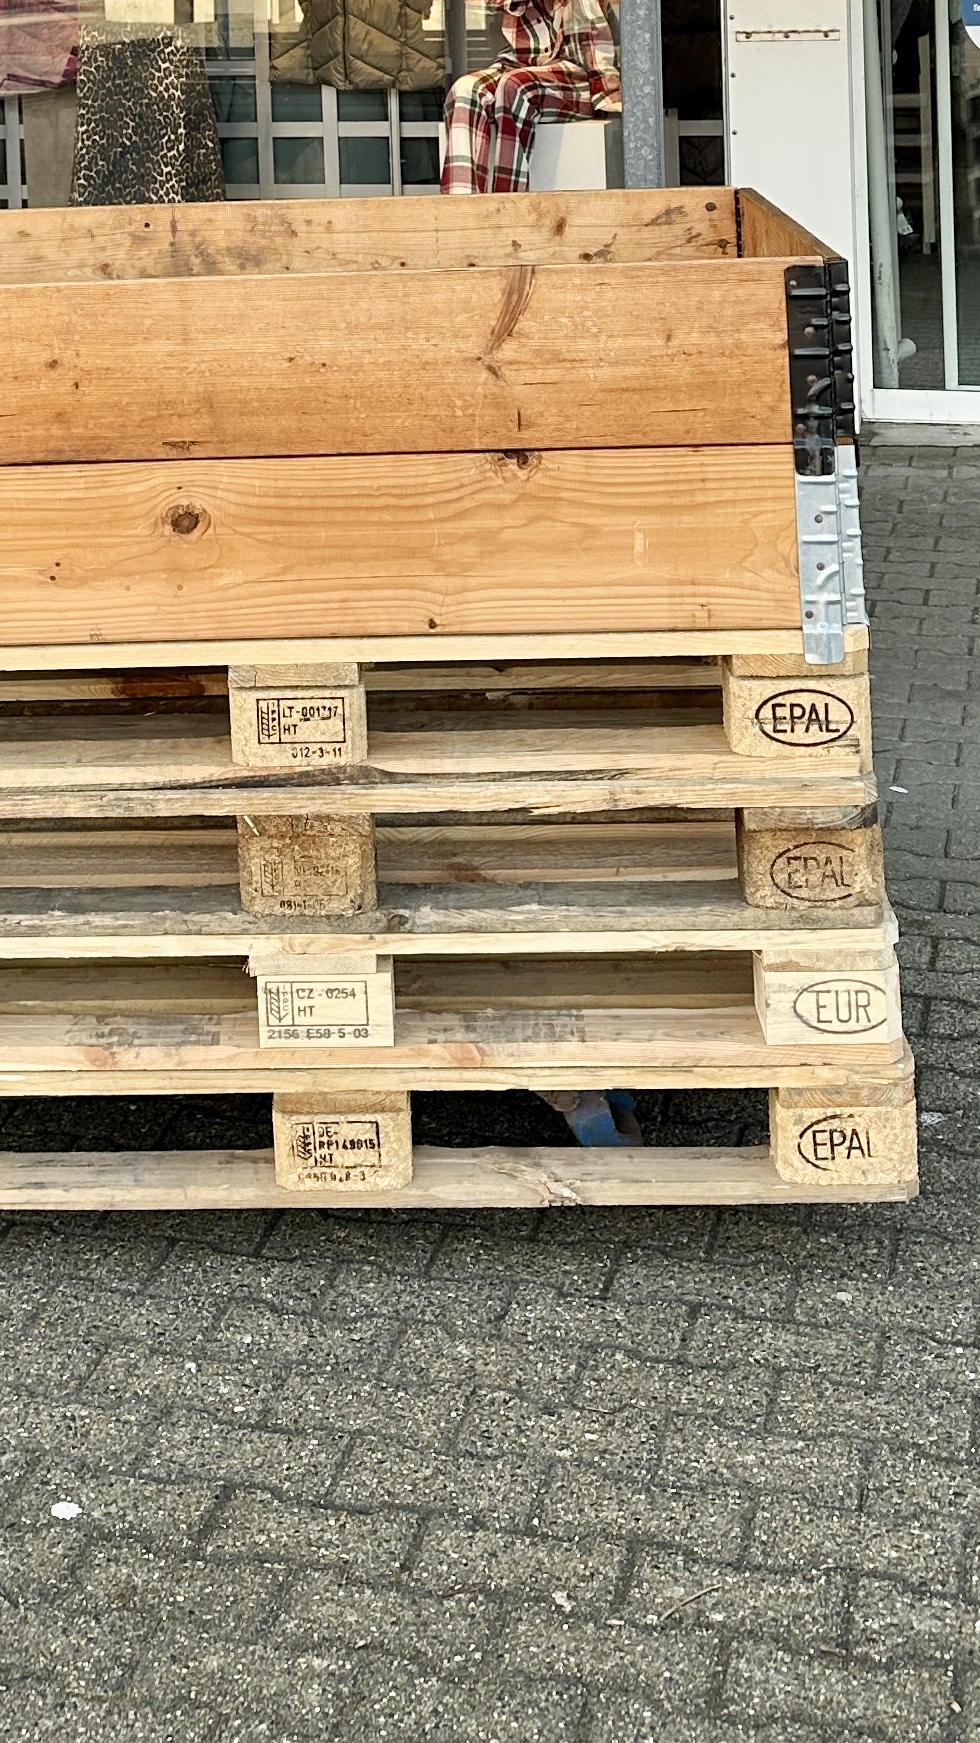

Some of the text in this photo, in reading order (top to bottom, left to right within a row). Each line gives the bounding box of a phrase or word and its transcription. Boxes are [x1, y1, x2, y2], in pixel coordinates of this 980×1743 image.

[771, 702, 841, 734] EPAL
[283, 724, 299, 736] HT
[785, 855, 853, 889] EPAL
[295, 987, 316, 1000] CZ
[297, 1005, 316, 1018] HT
[815, 989, 872, 1024] EUR
